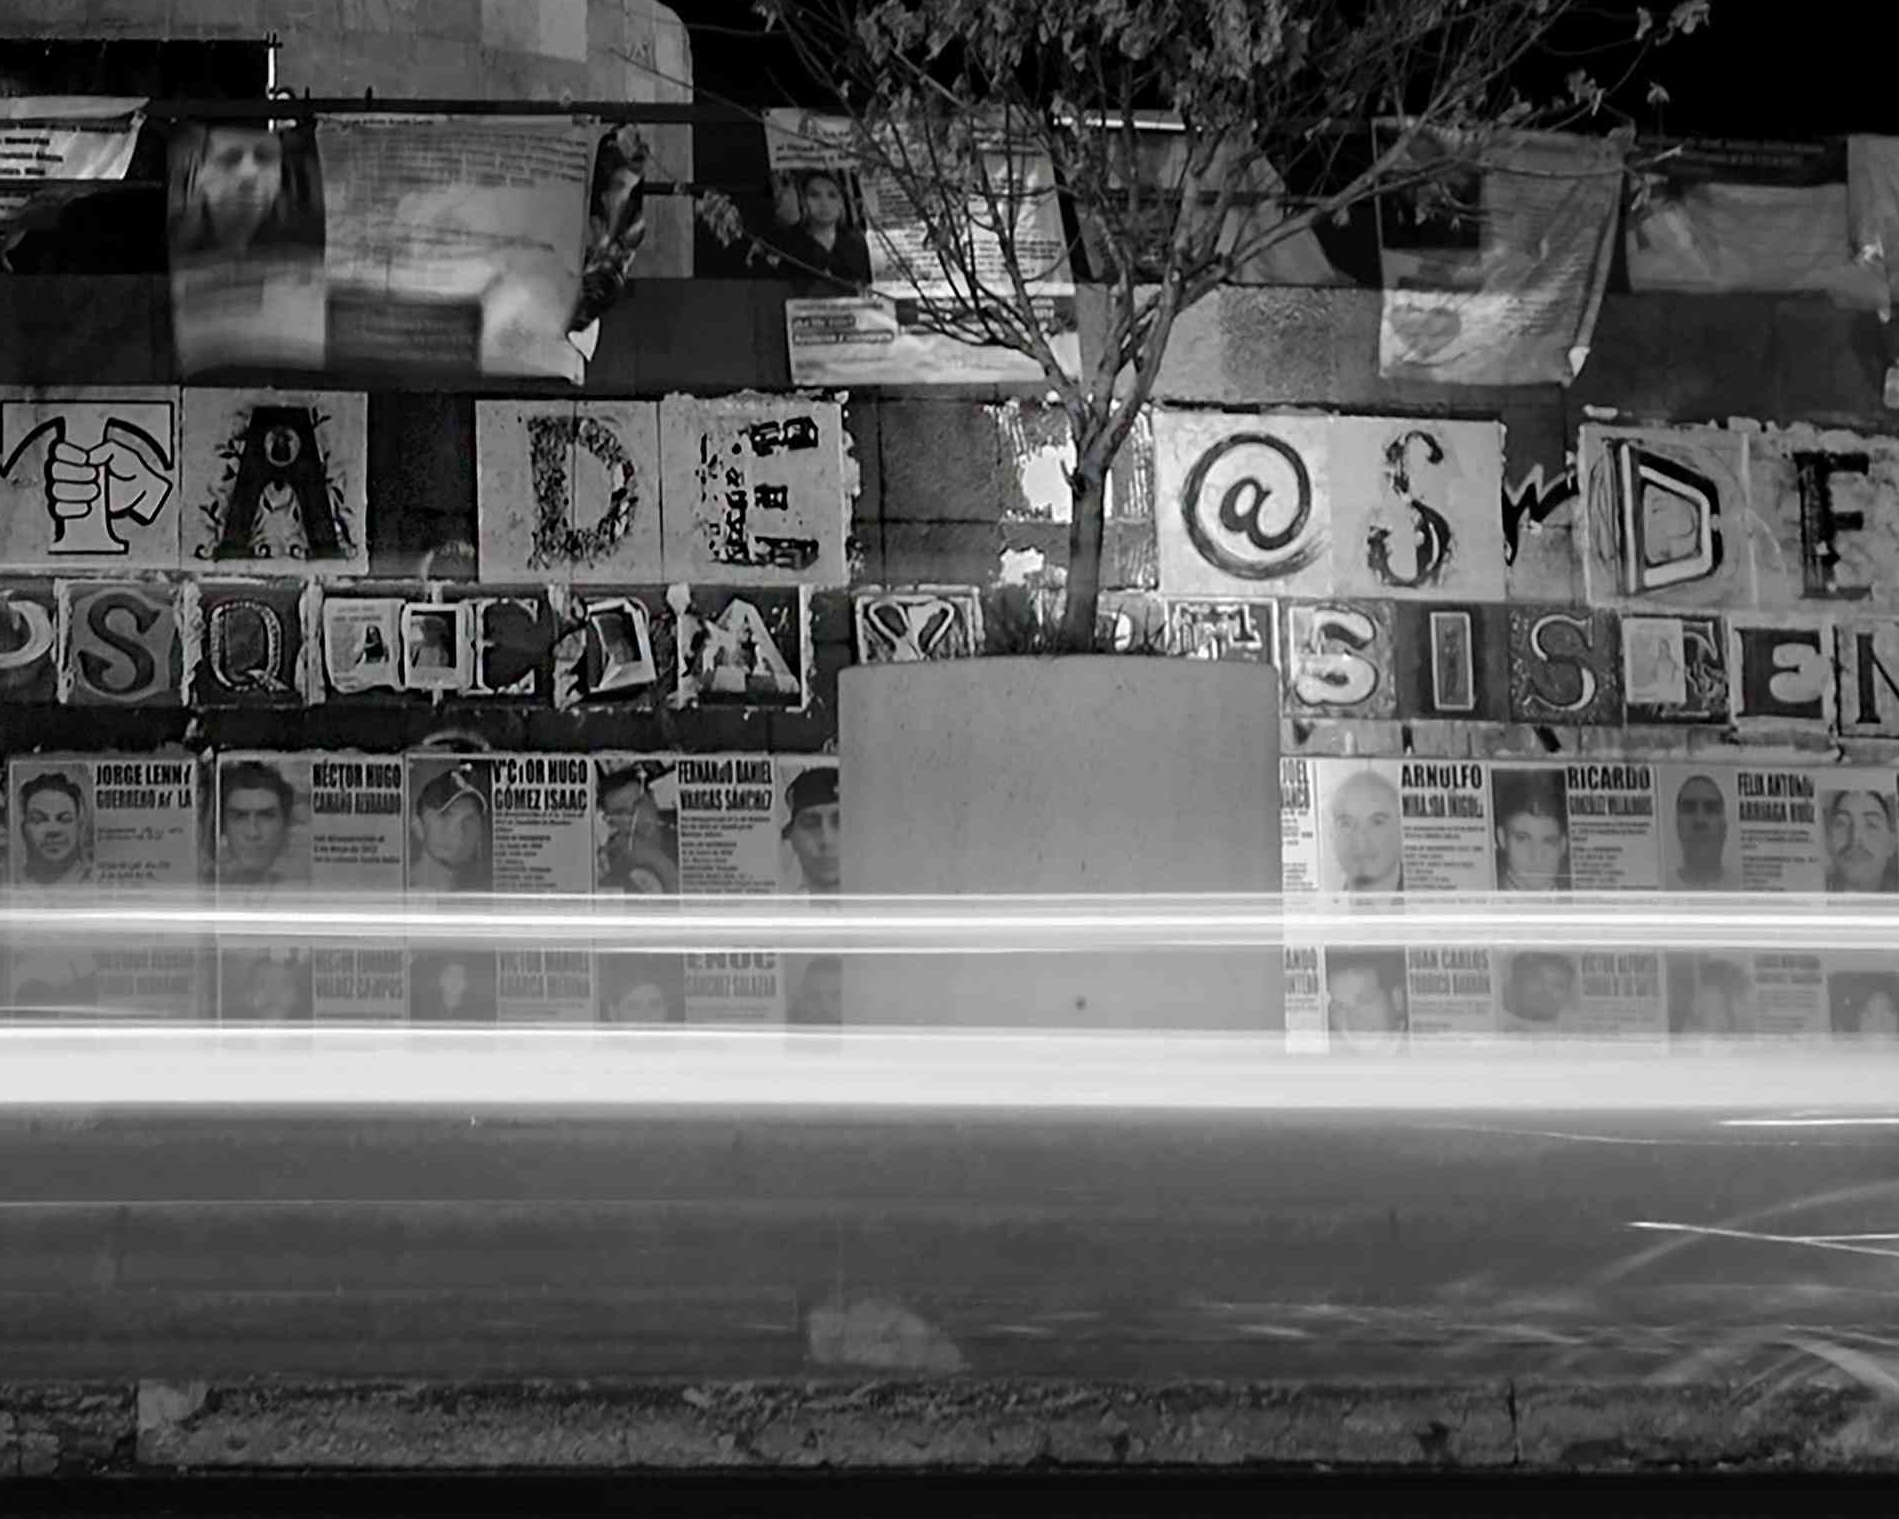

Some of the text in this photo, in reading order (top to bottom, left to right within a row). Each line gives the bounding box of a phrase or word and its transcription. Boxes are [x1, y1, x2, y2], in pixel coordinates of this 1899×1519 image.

[528, 411, 821, 567] DE
[96, 764, 140, 787] JORGE
[366, 764, 402, 789] HUGO
[548, 758, 588, 784] HUGO
[736, 759, 773, 785] DANIEL
[1401, 764, 1483, 789] ARNULFO
[1567, 766, 1652, 790] RICARDO
[544, 787, 588, 810] ISAAC
